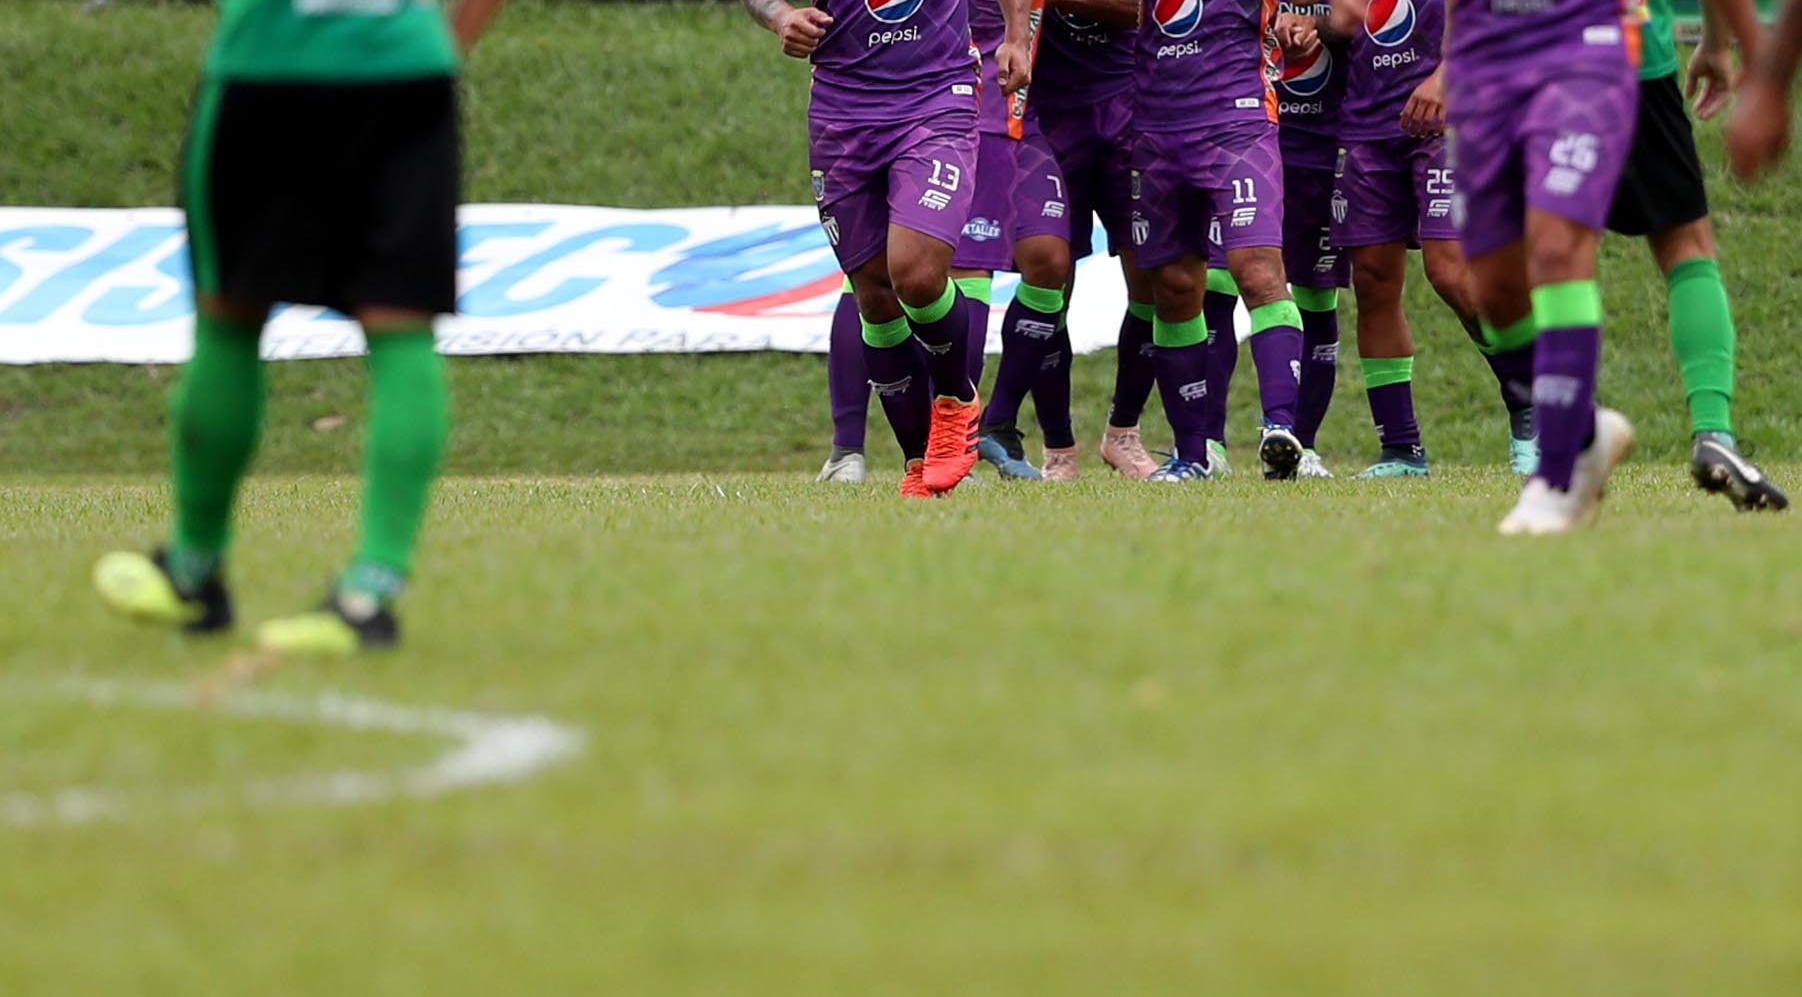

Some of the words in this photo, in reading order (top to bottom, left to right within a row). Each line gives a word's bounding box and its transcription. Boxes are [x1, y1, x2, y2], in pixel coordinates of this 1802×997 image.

[868, 24, 922, 48] pepsi
[1157, 40, 1202, 60] pepsi
[1372, 47, 1420, 71] pepsi
[1278, 100, 1324, 115] pepsi
[926, 159, 961, 193] 13
[1046, 174, 1063, 198] 7
[1426, 168, 1455, 194] 25
[1231, 177, 1257, 204] 11
[616, 327, 774, 353] PARA
